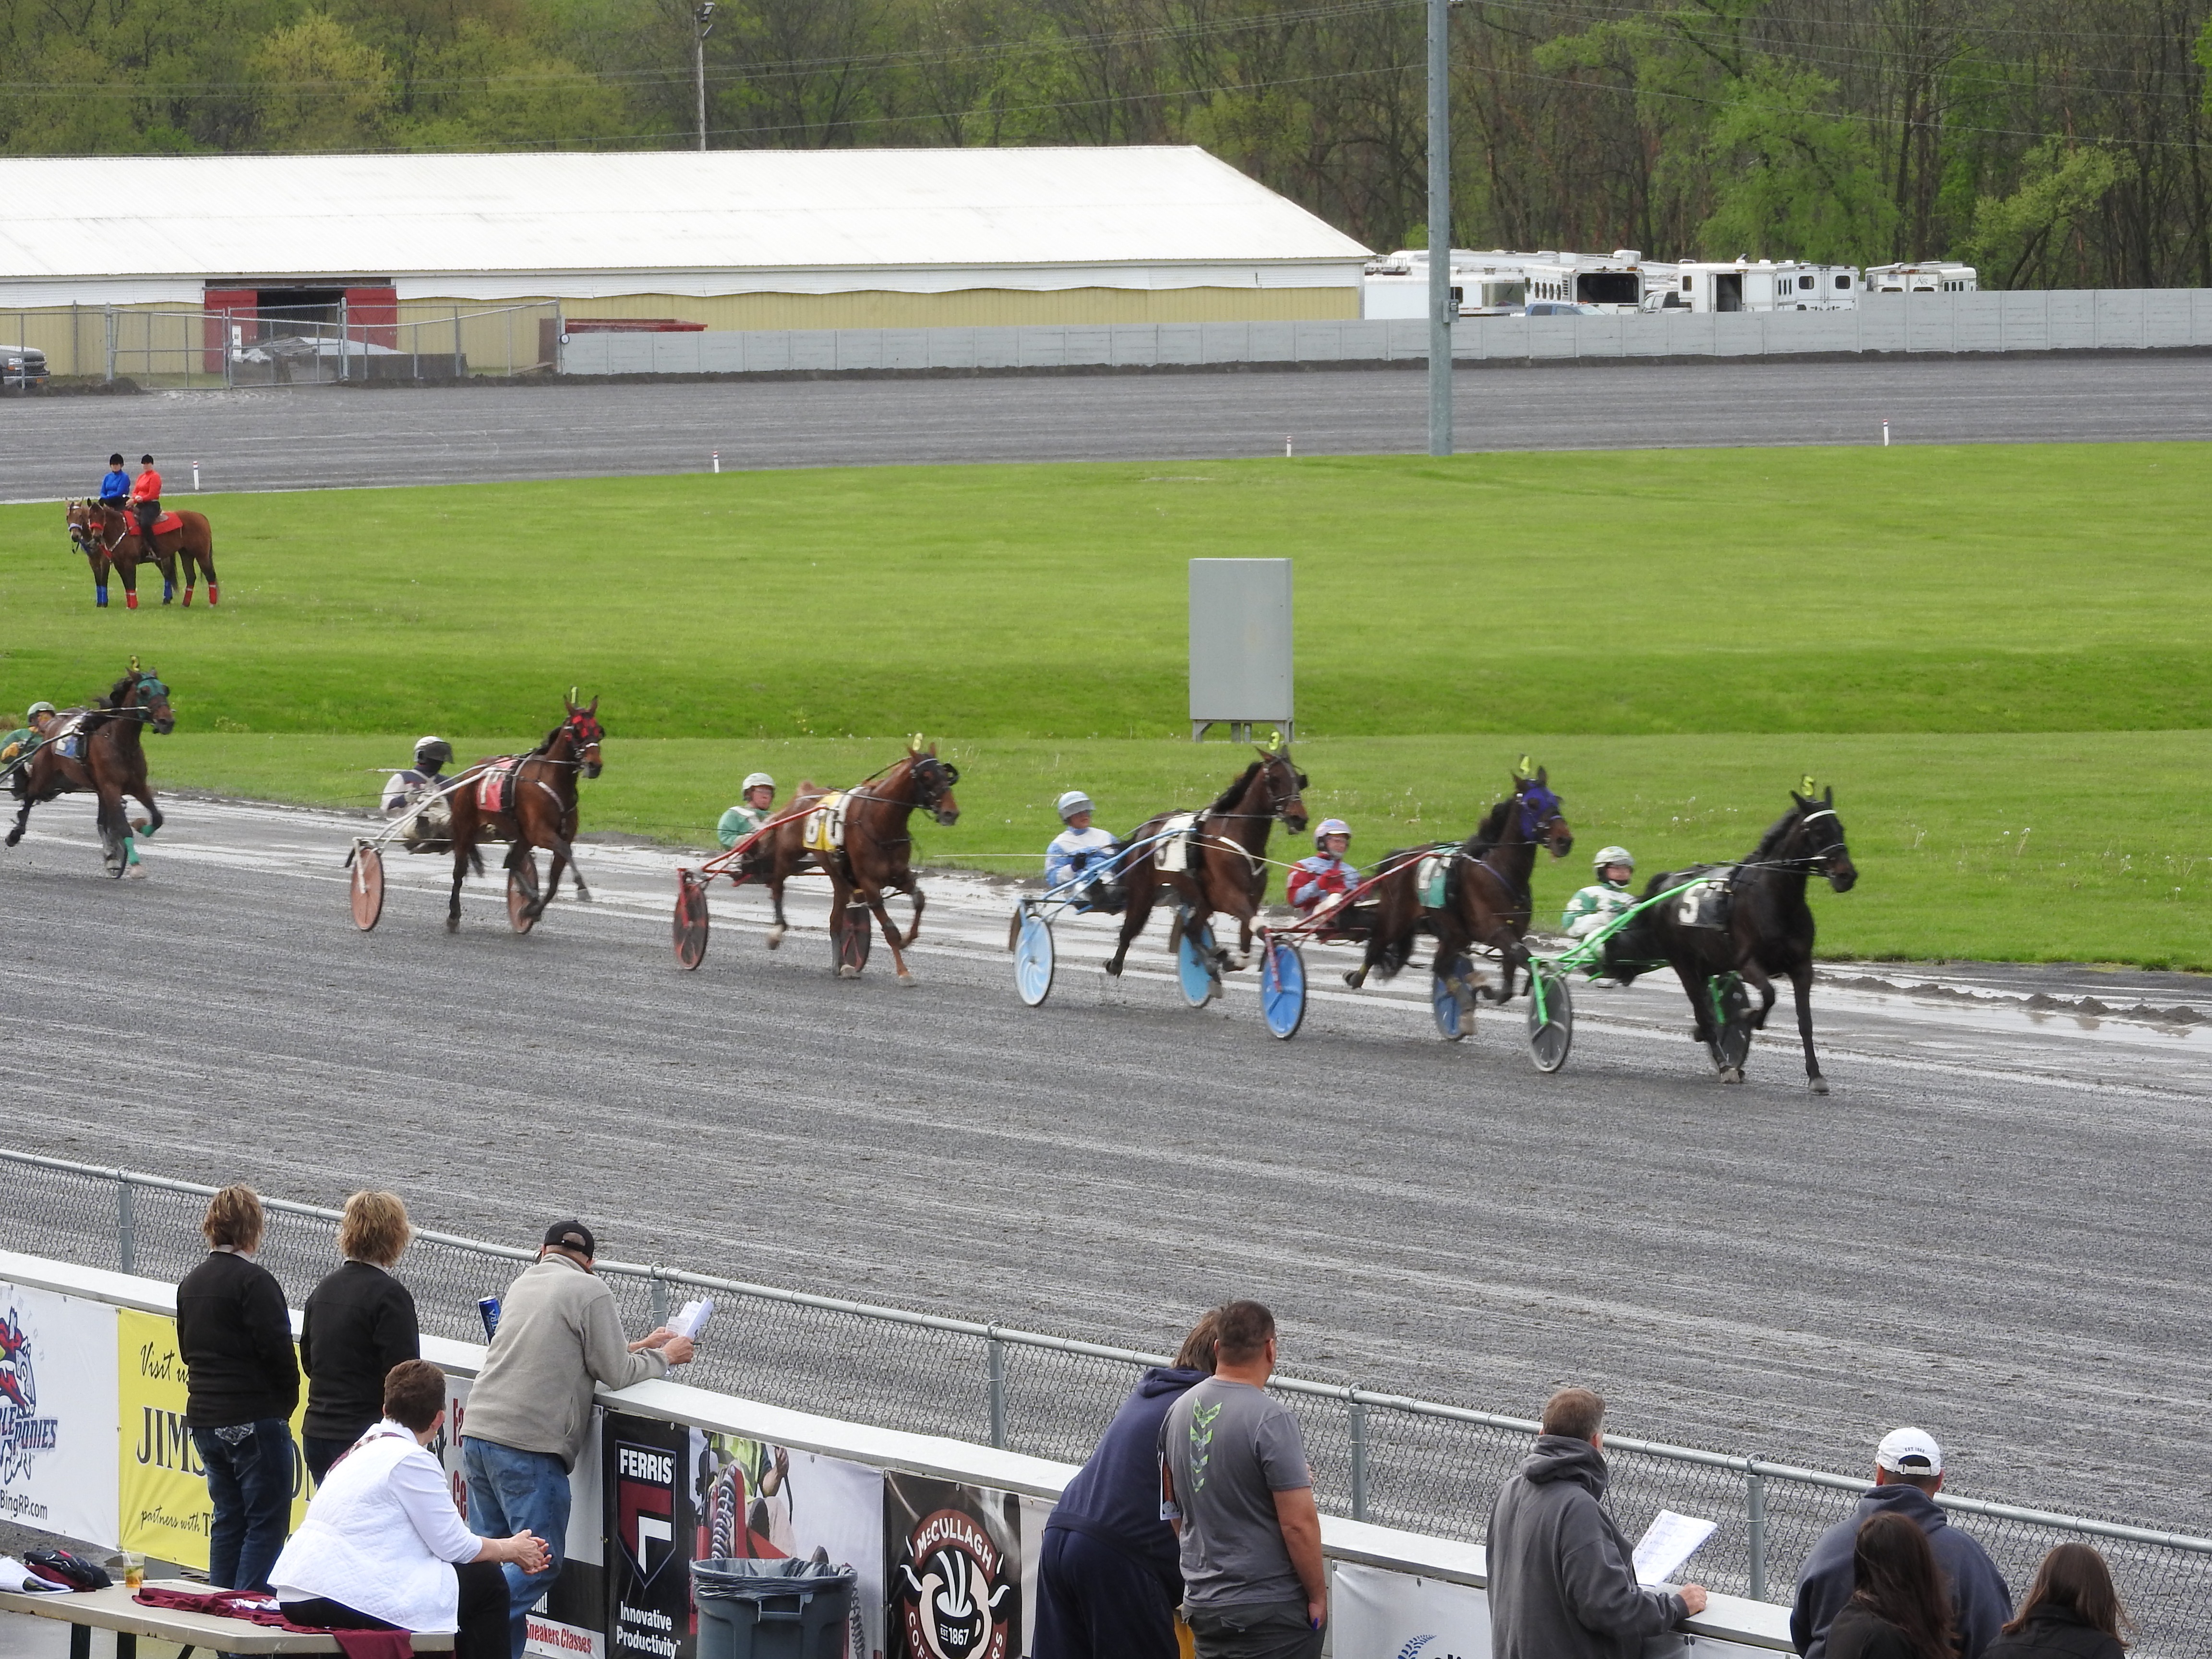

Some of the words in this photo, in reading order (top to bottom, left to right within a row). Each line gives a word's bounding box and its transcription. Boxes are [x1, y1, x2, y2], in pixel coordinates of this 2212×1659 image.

[1269, 732, 1280, 750] 3
[1802, 776, 1814, 796] 5
[1679, 882, 1708, 923] 5
[140, 1341, 175, 1381] Visit
[13, 1419, 58, 1456] PONIES
[620, 1448, 672, 1484] FERRIS
[0, 1489, 48, 1520] BingRP.com
[141, 1505, 179, 1530] partners
[180, 1512, 201, 1532] with
[917, 1517, 993, 1571] McCULLAGH
[620, 1600, 672, 1631] Innovative
[561, 1628, 591, 1654] Classes
[940, 1626, 949, 1637] EST
[949, 1627, 969, 1646] 1867
